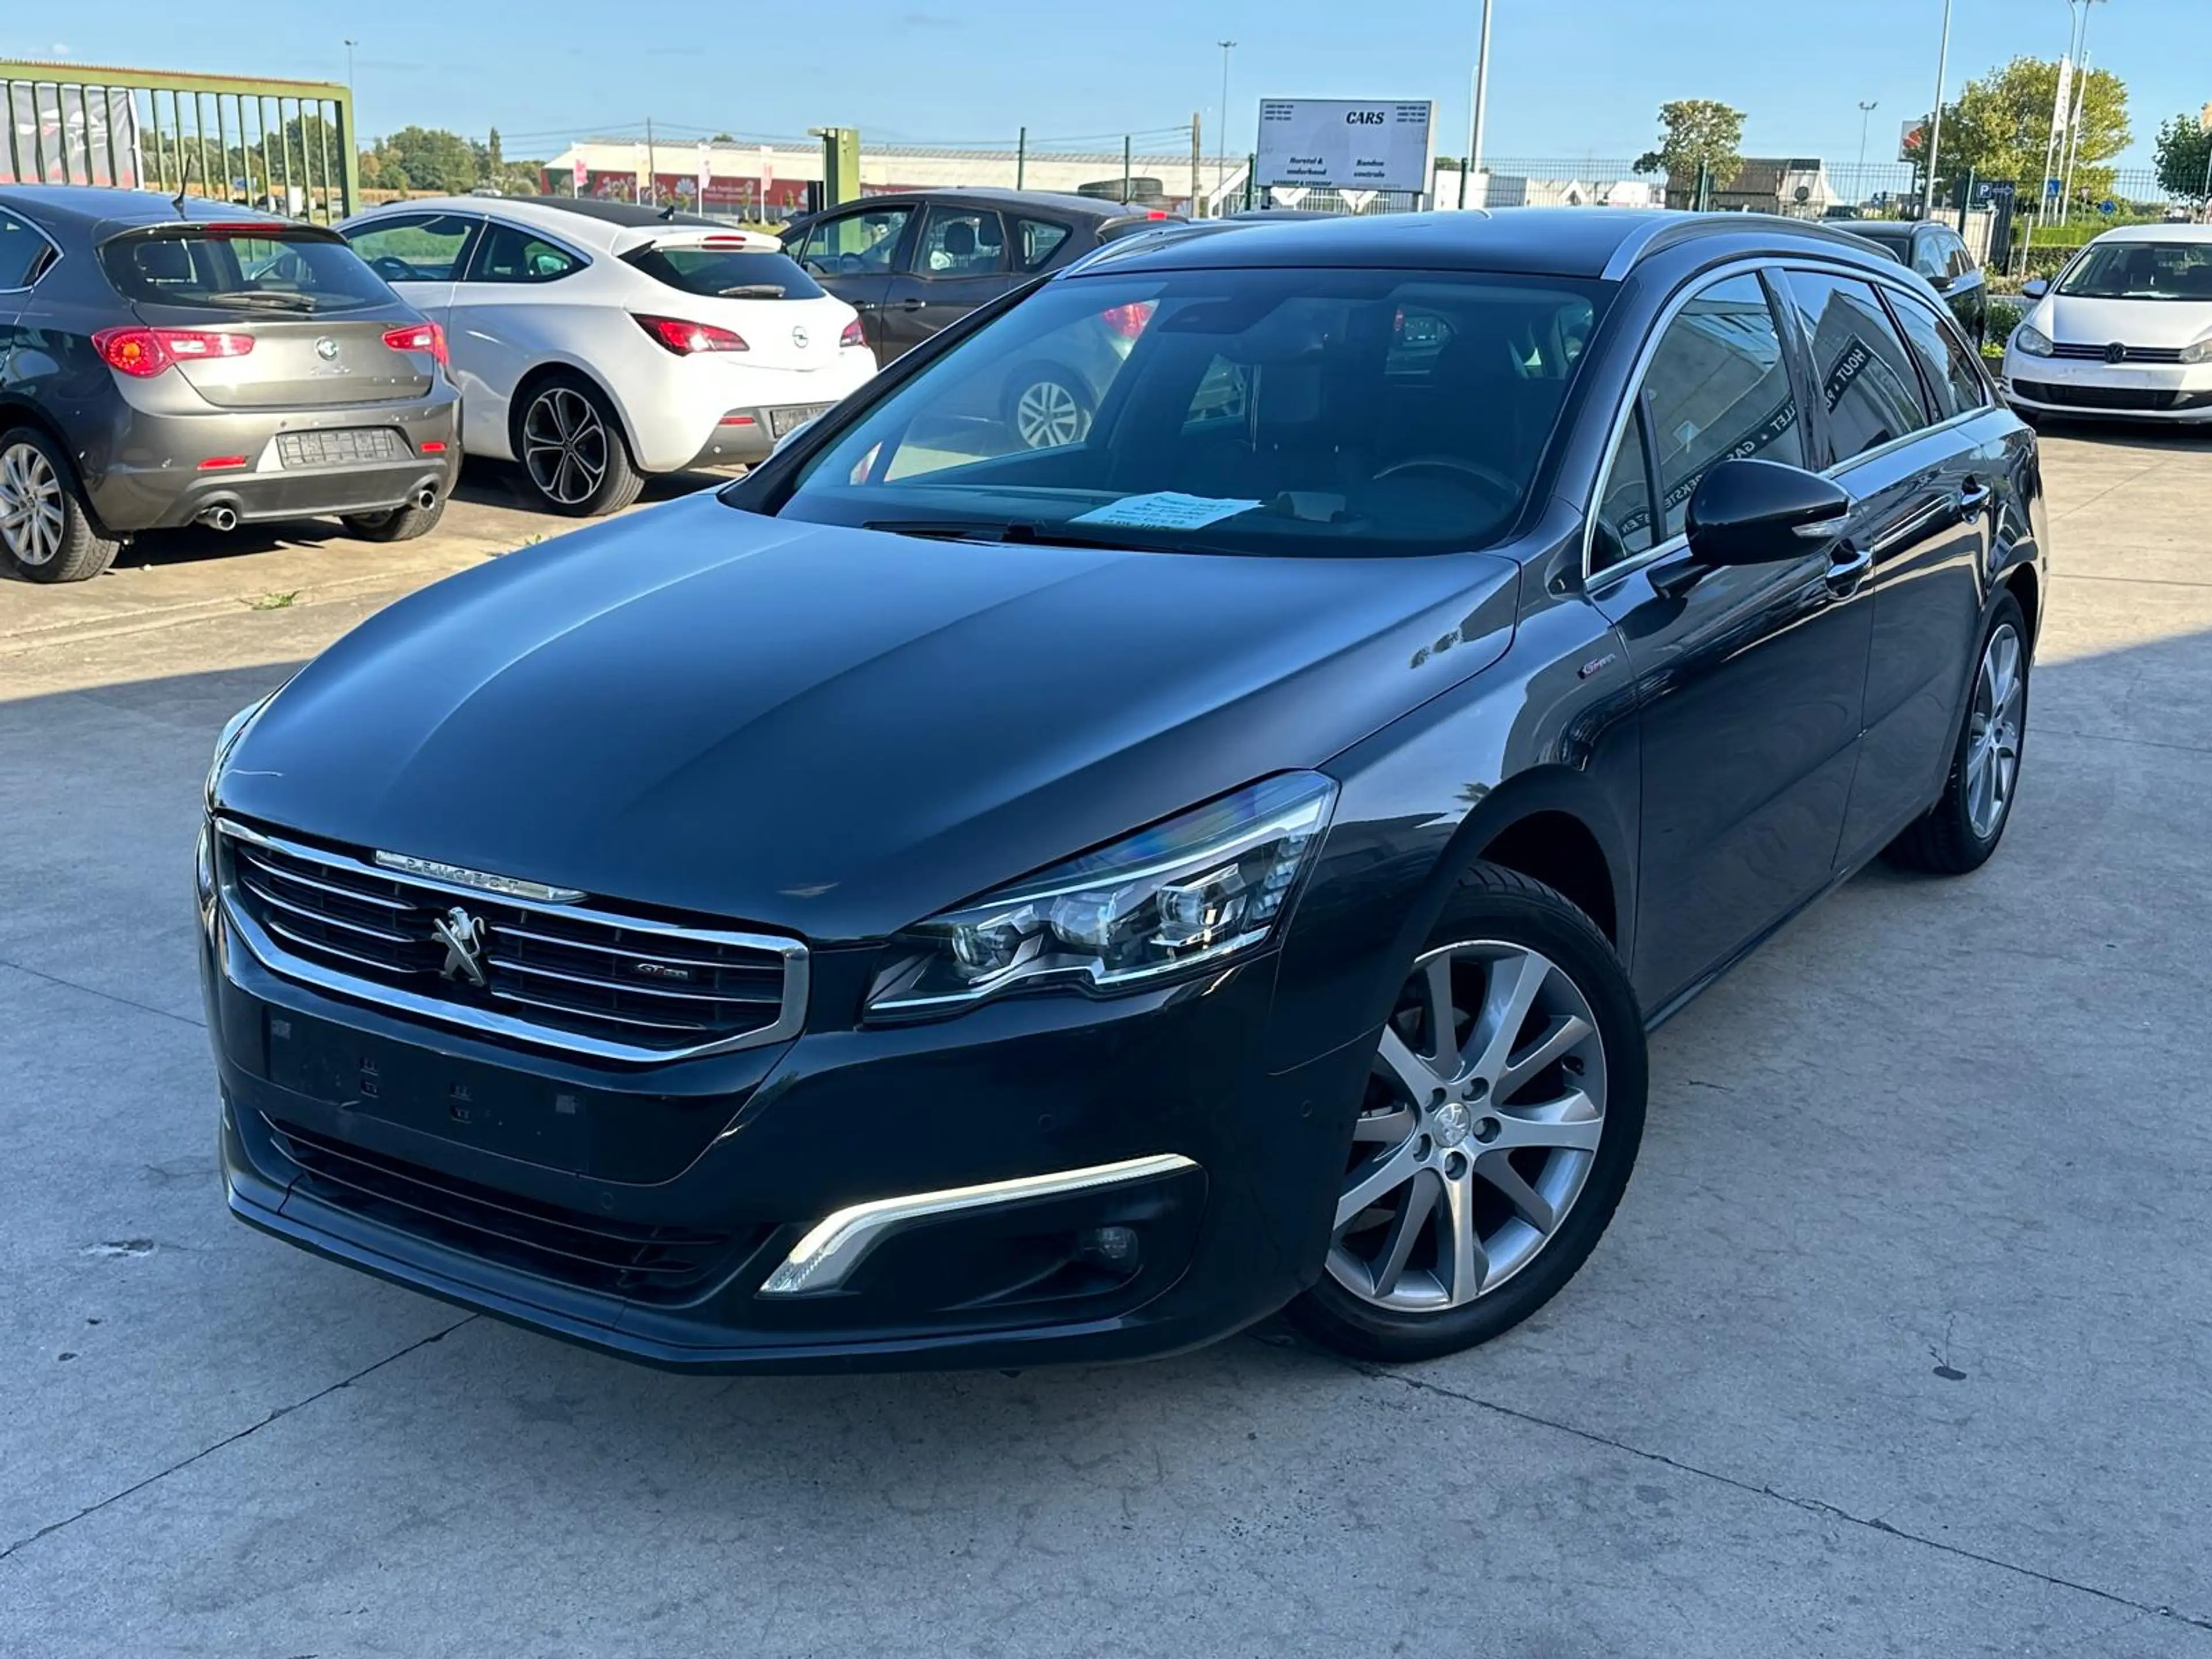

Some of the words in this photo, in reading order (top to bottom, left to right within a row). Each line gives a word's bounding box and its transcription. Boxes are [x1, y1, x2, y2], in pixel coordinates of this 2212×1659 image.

[1347, 111, 1384, 124] CARS
[1980, 183, 1989, 196] P
[406, 857, 520, 892] PEUGEOT
